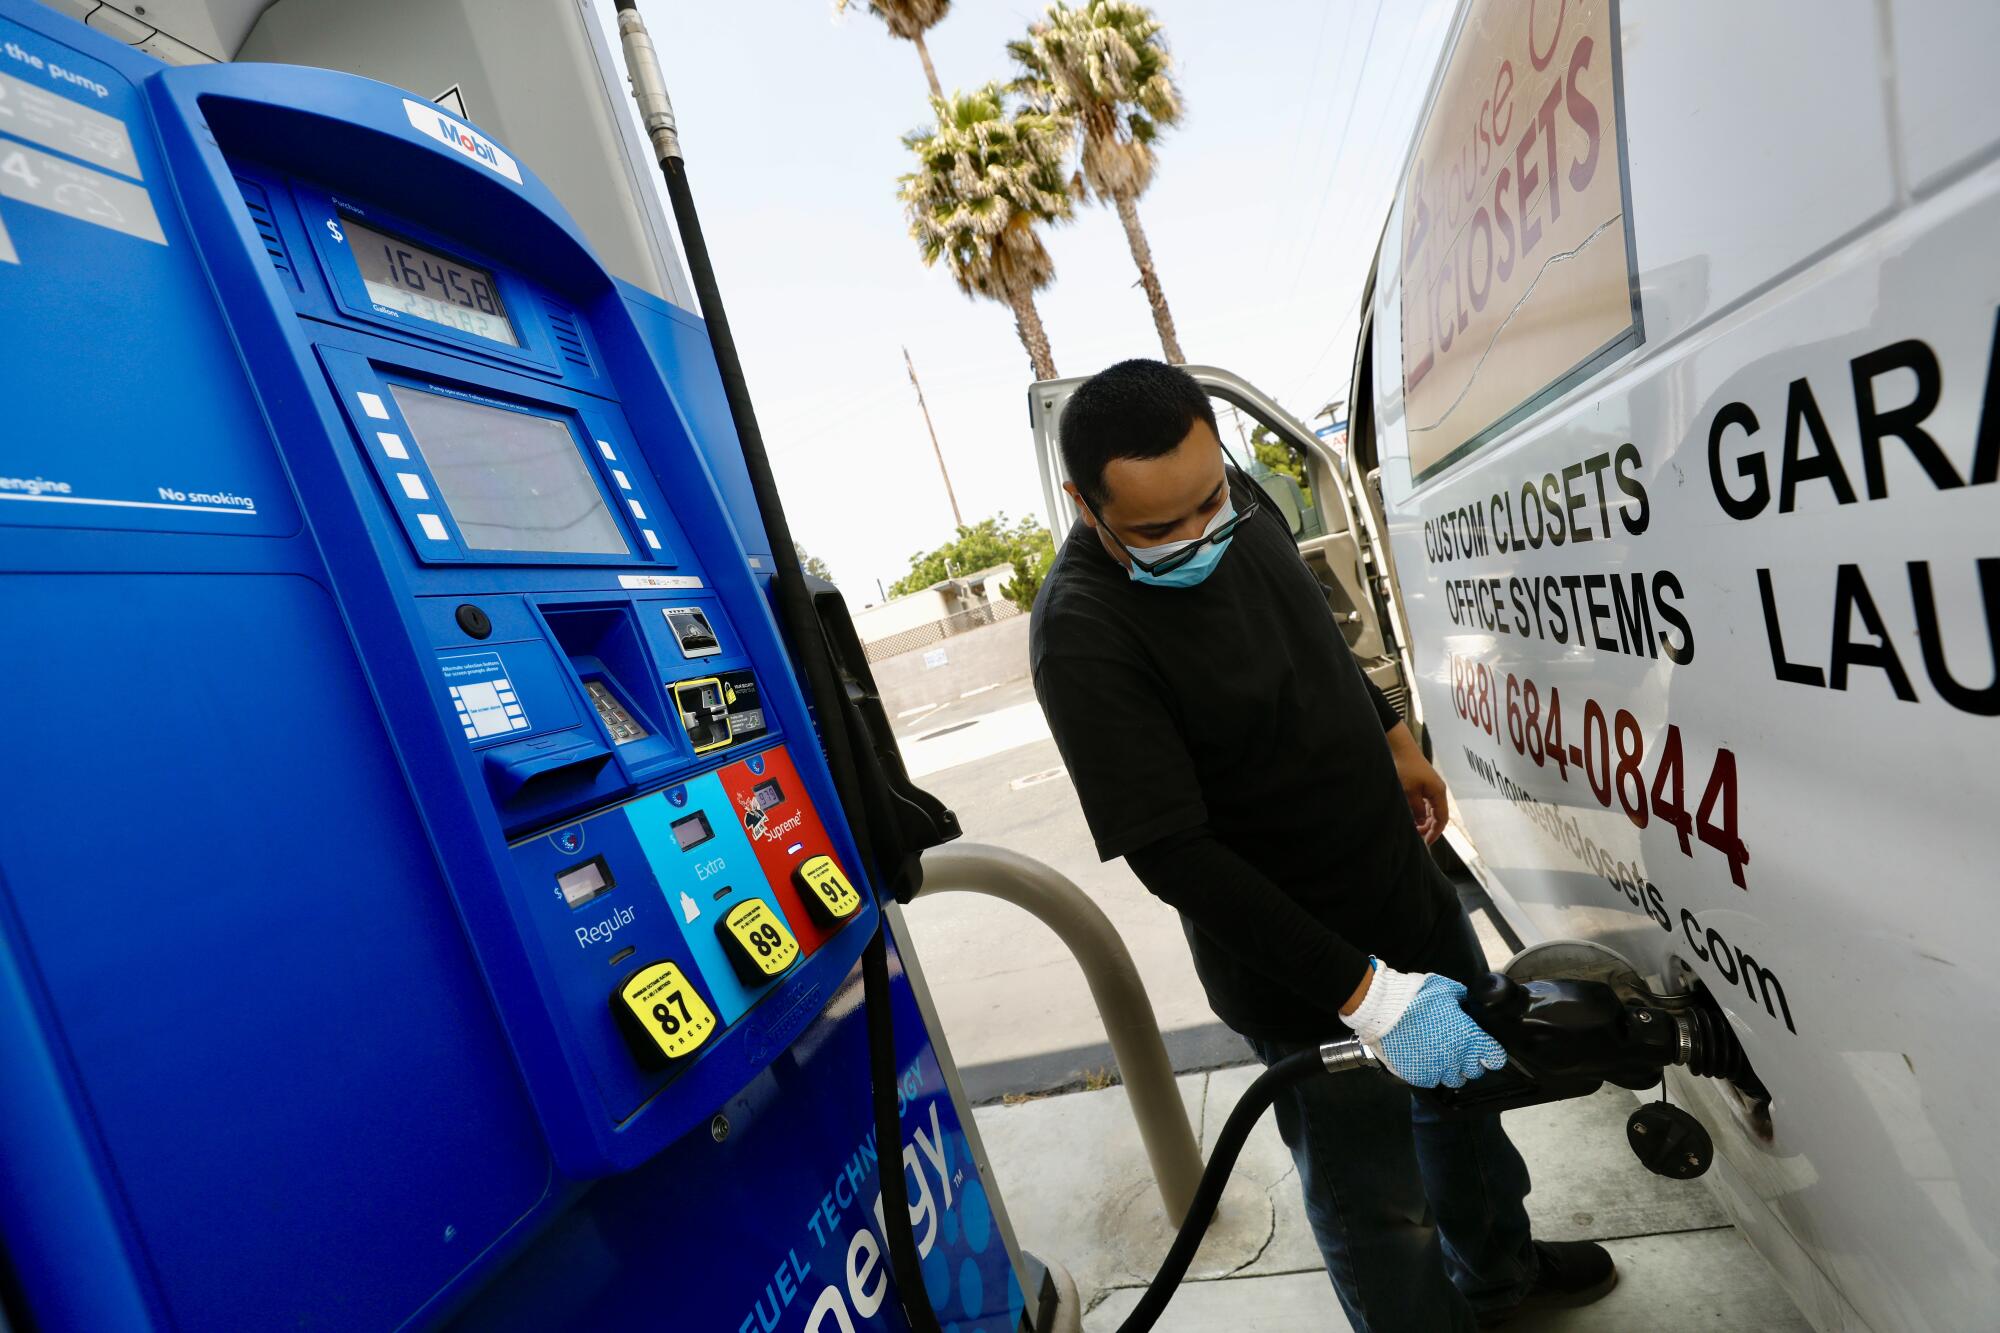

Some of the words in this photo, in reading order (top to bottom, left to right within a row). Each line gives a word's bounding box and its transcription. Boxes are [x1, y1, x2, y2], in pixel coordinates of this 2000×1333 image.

[4, 43, 44, 70] the
[48, 63, 109, 98] pump
[438, 118, 498, 167] Mobil
[1436, 36, 1600, 353] CLOSETS
[326, 218, 344, 243] $
[373, 303, 400, 318] Gallons
[158, 487, 186, 502] No
[188, 491, 254, 510] smoking
[1424, 500, 1489, 564] CUSTOM
[1490, 442, 1650, 555] CLOSETS
[1445, 577, 1511, 634] OFFICE
[1509, 569, 1695, 666] SYSTEMS
[1450, 650, 1501, 746] (888)
[1507, 672, 1750, 892] 684-0844
[694, 857, 726, 881] Extra
[820, 876, 849, 903] 91
[575, 905, 636, 949] Regular
[749, 923, 782, 957] 89
[652, 989, 693, 1035] 87
